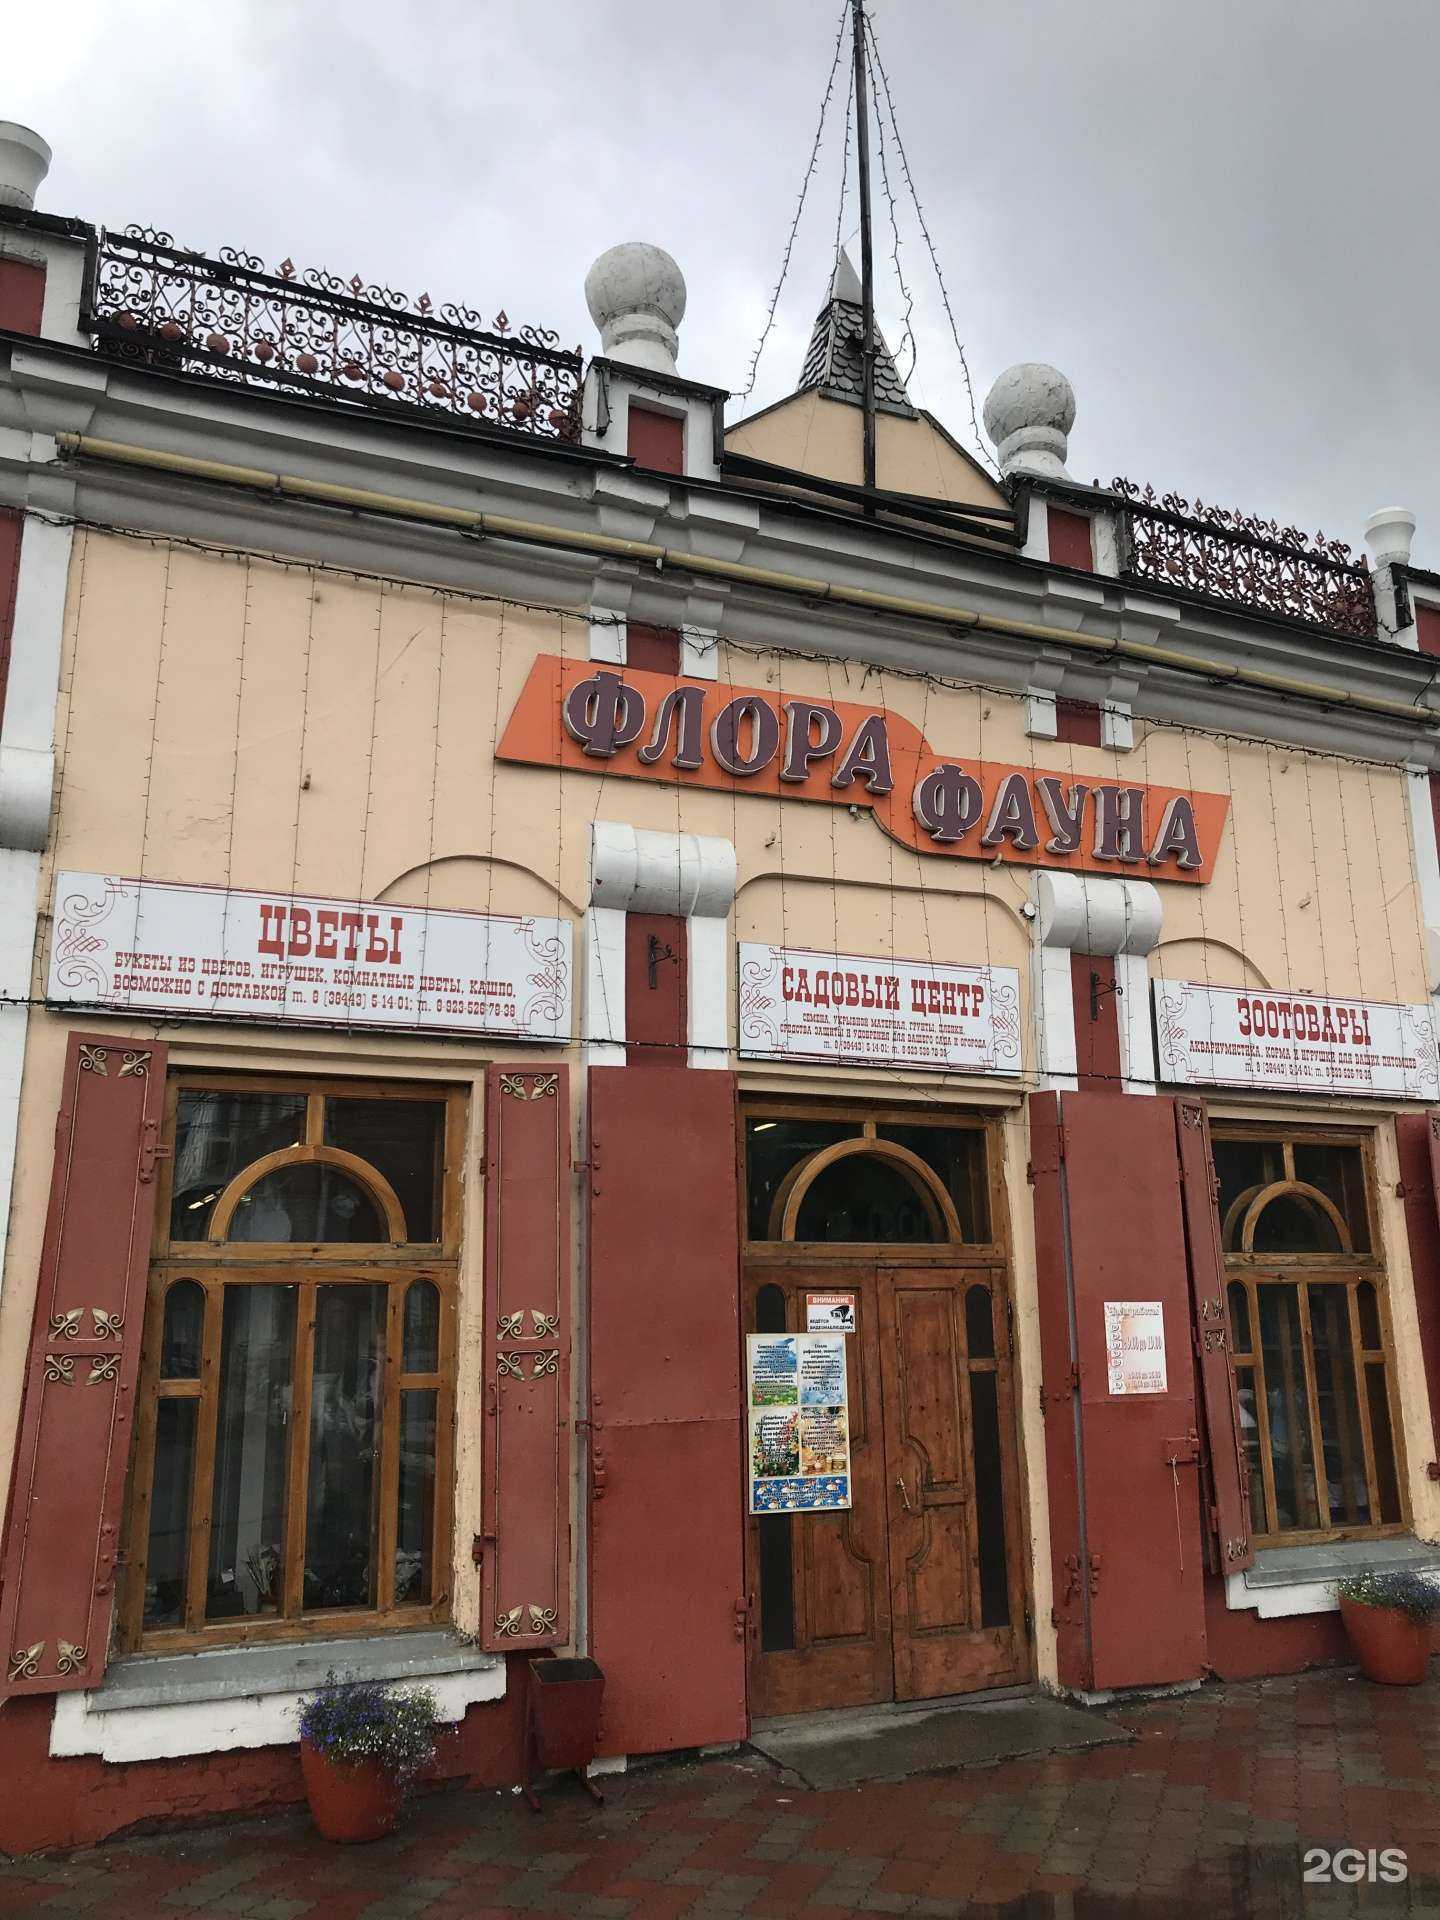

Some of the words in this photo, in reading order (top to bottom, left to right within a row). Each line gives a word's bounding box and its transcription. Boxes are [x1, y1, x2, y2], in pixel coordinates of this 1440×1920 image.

[563, 671, 895, 795] ФЛОРА
[913, 764, 1204, 870] ФАУНА
[258, 904, 403, 965] ЦВЕТЫ
[112, 974, 192, 995] ВОЗМОЖНО
[198, 980, 205, 995] С
[210, 981, 286, 1002] ДОСТАВКОЙ
[312, 992, 319, 1005] 8
[114, 951, 172, 973] БУКЕТЫ
[178, 957, 196, 974] ИЗ
[333, 968, 415, 990] КОМНАТНЫЕ
[782, 967, 900, 1010] САДОВЫЙ
[911, 979, 985, 1017] ЦЕНТР
[780, 1023, 812, 1035] СРЕДСТВА
[907, 1034, 933, 1044] ВАШЕГО
[935, 1036, 952, 1046] САДА
[1237, 997, 1371, 1046] ЗООТОВАРЫ
[1265, 1046, 1291, 1059] КОРМА
[1338, 1052, 1353, 1065] ДЛЯ
[1382, 1055, 1417, 1070] ПИТОМЦЕВ
[812, 1296, 849, 1304] ВНИМАНИЕ
